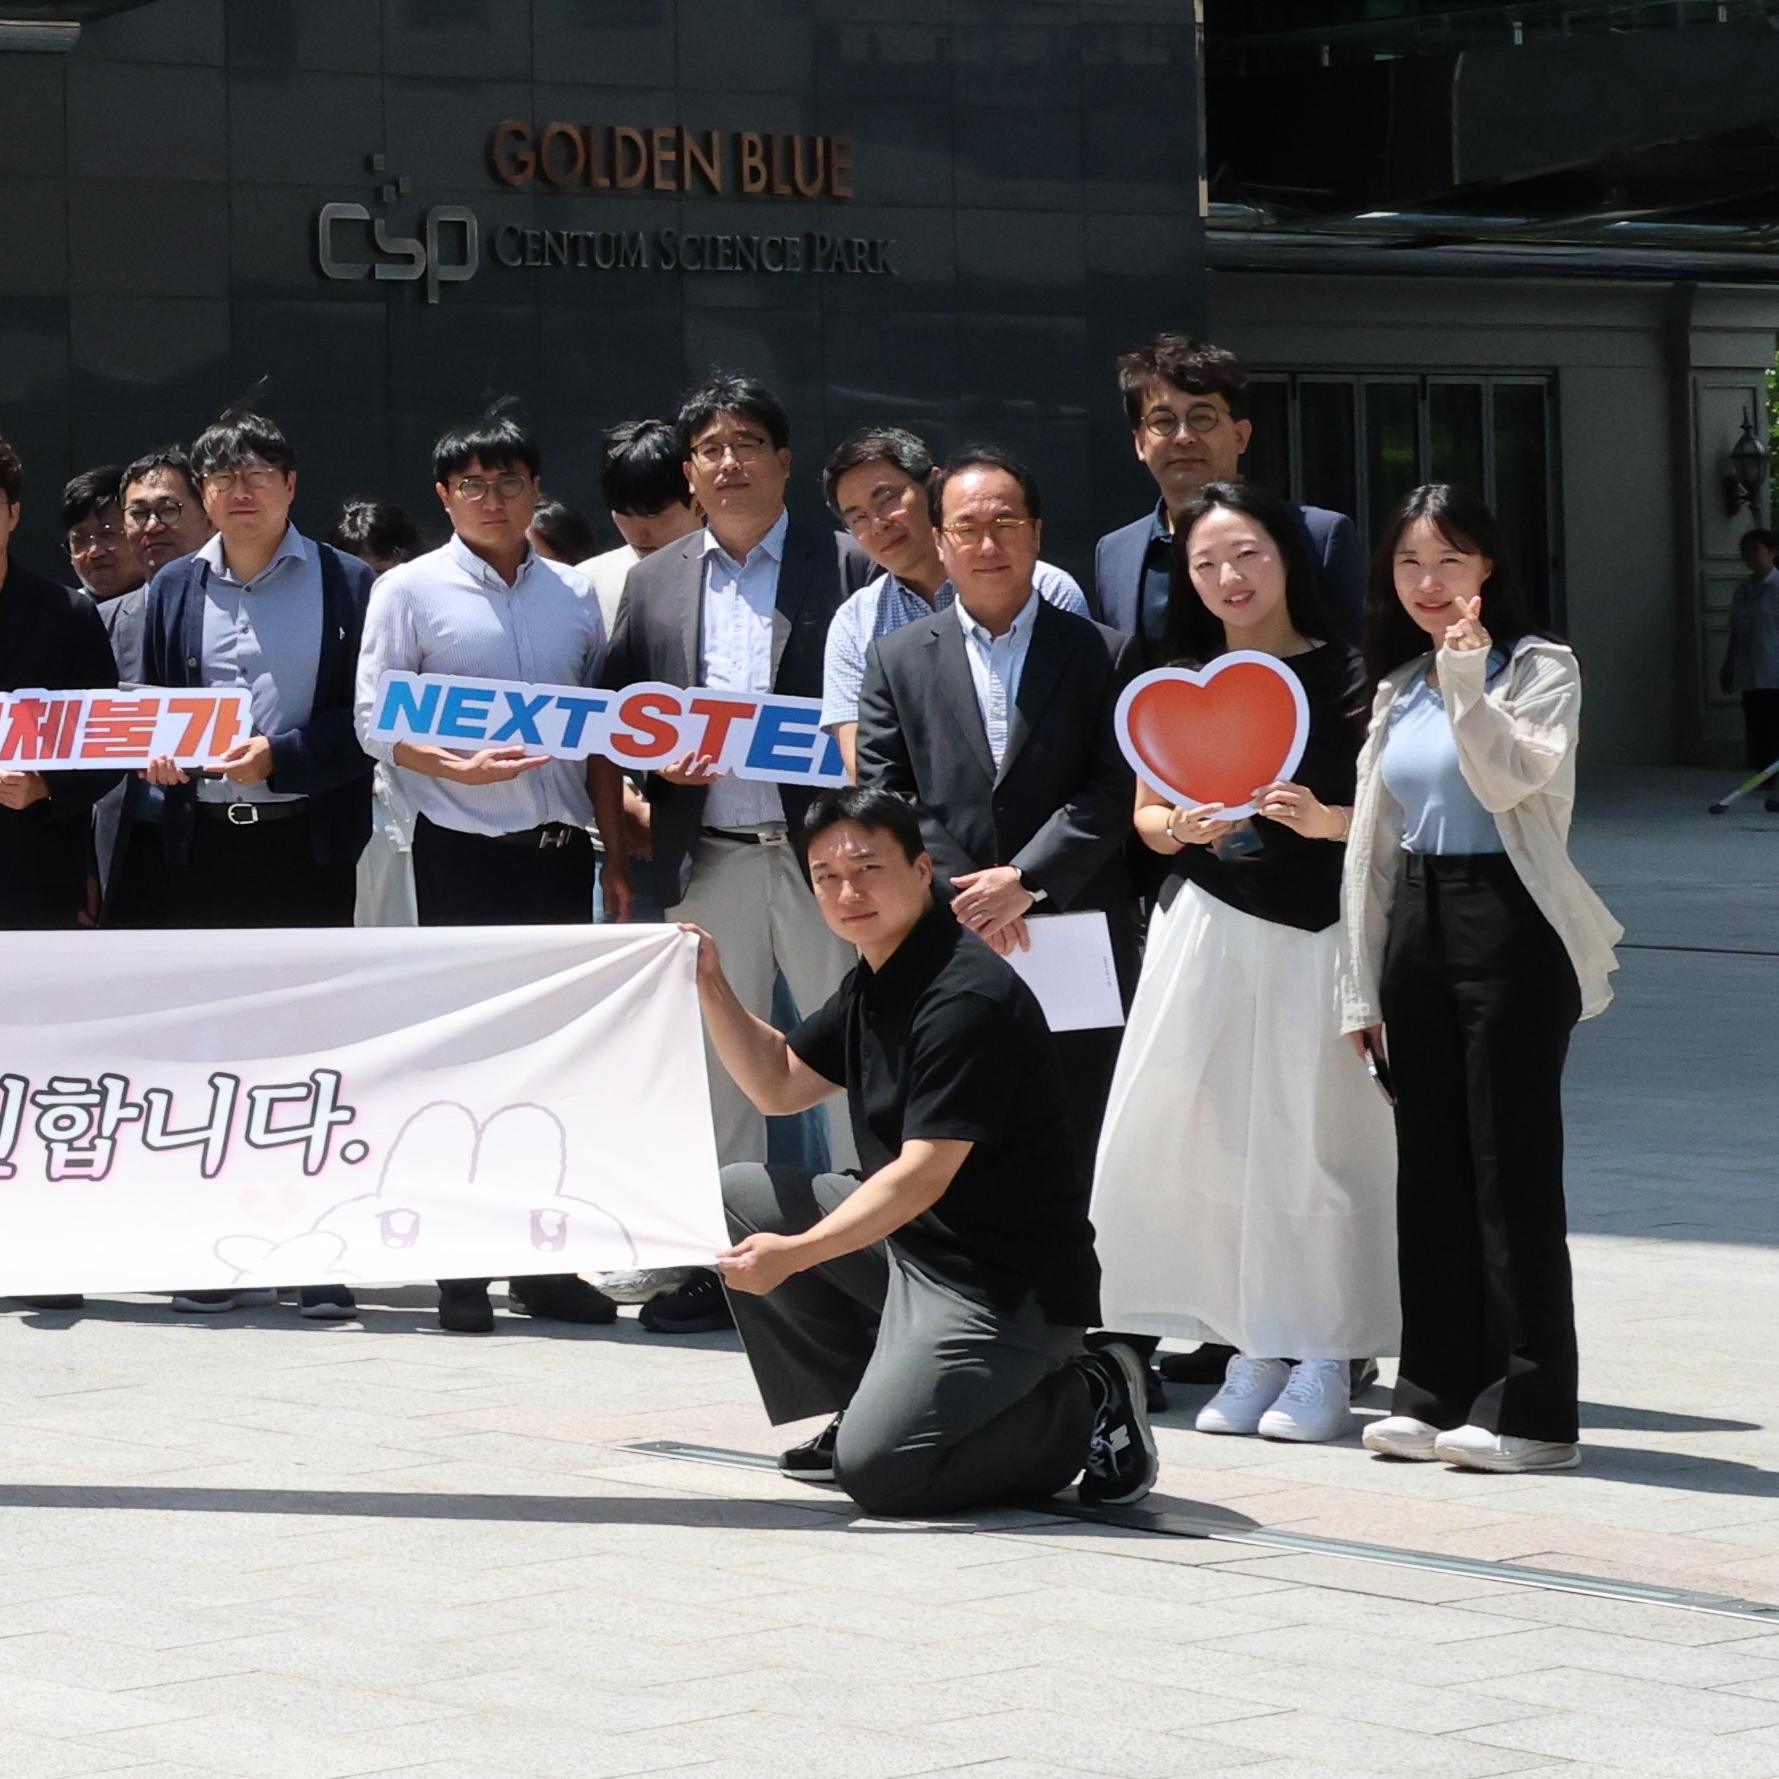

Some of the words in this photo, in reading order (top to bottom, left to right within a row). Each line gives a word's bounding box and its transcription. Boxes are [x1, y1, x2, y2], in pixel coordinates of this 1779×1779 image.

[492, 120, 723, 194] GOLDEN
[741, 130, 854, 198] BLUE
[377, 680, 608, 749] NEXT
